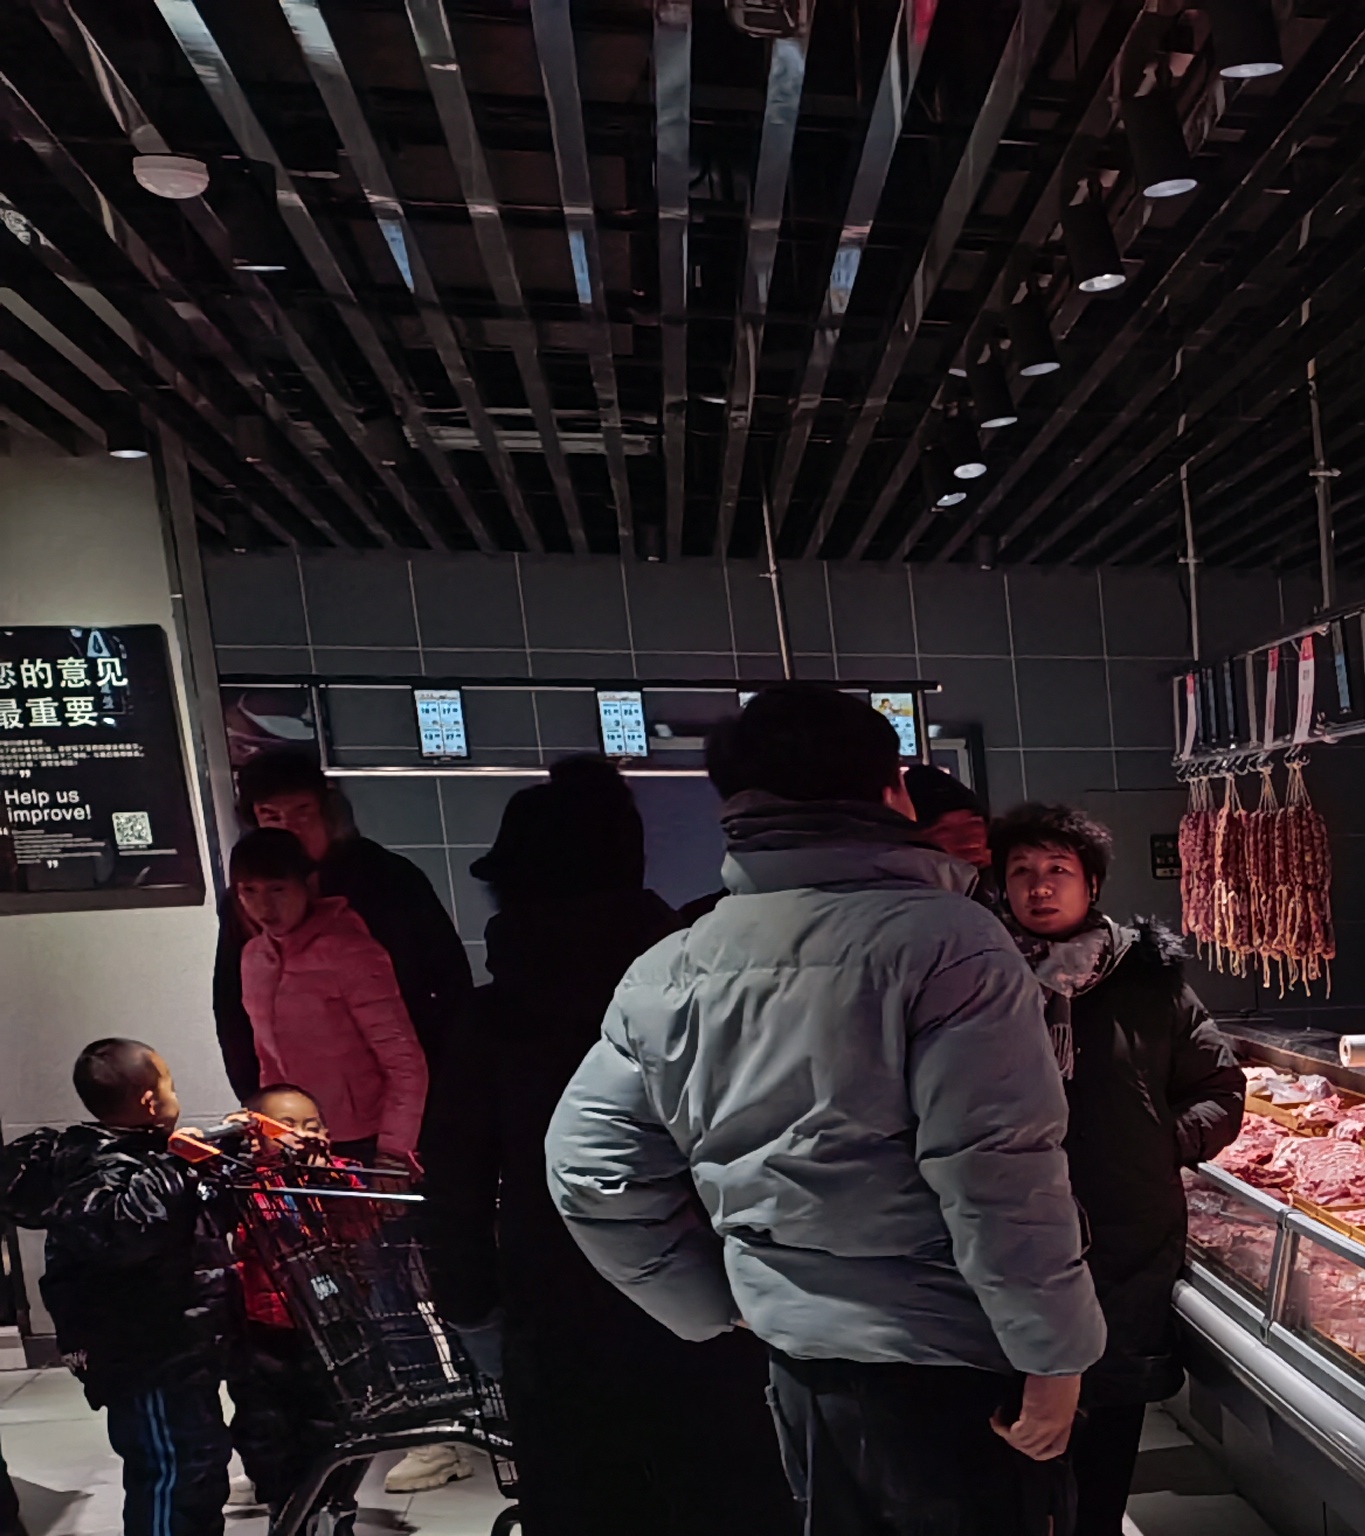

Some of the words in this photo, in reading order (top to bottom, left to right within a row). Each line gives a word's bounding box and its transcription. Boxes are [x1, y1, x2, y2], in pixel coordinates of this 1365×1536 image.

[0, 696, 99, 730] 最重要
[4, 788, 50, 808] Help
[56, 789, 81, 804] us
[7, 804, 93, 826] improve!
